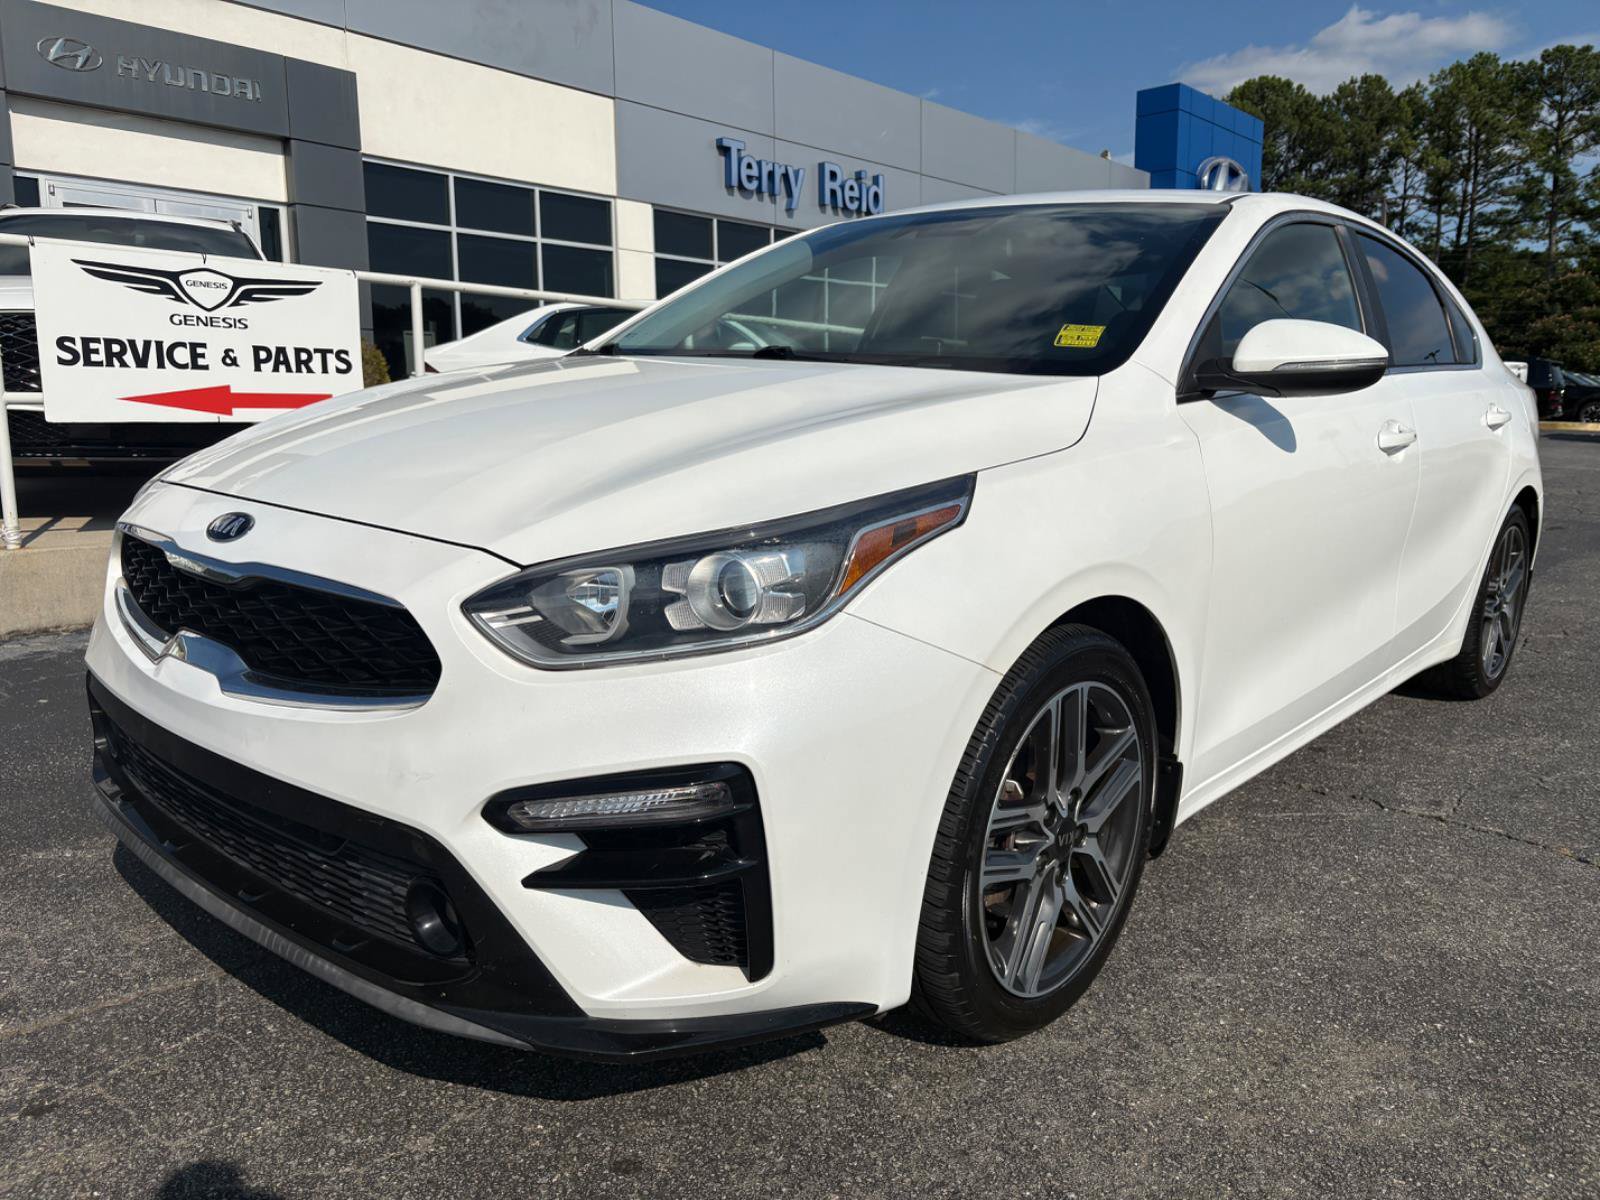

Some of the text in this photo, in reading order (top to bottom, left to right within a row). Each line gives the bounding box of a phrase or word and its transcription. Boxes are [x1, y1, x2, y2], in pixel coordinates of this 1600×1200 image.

[117, 55, 262, 102] HYUNDAI
[716, 137, 885, 215] Terry Reid
[185, 279, 228, 290] GENESIS
[169, 313, 249, 330] GENESIS
[56, 336, 353, 374] SERVICE & PARTS
